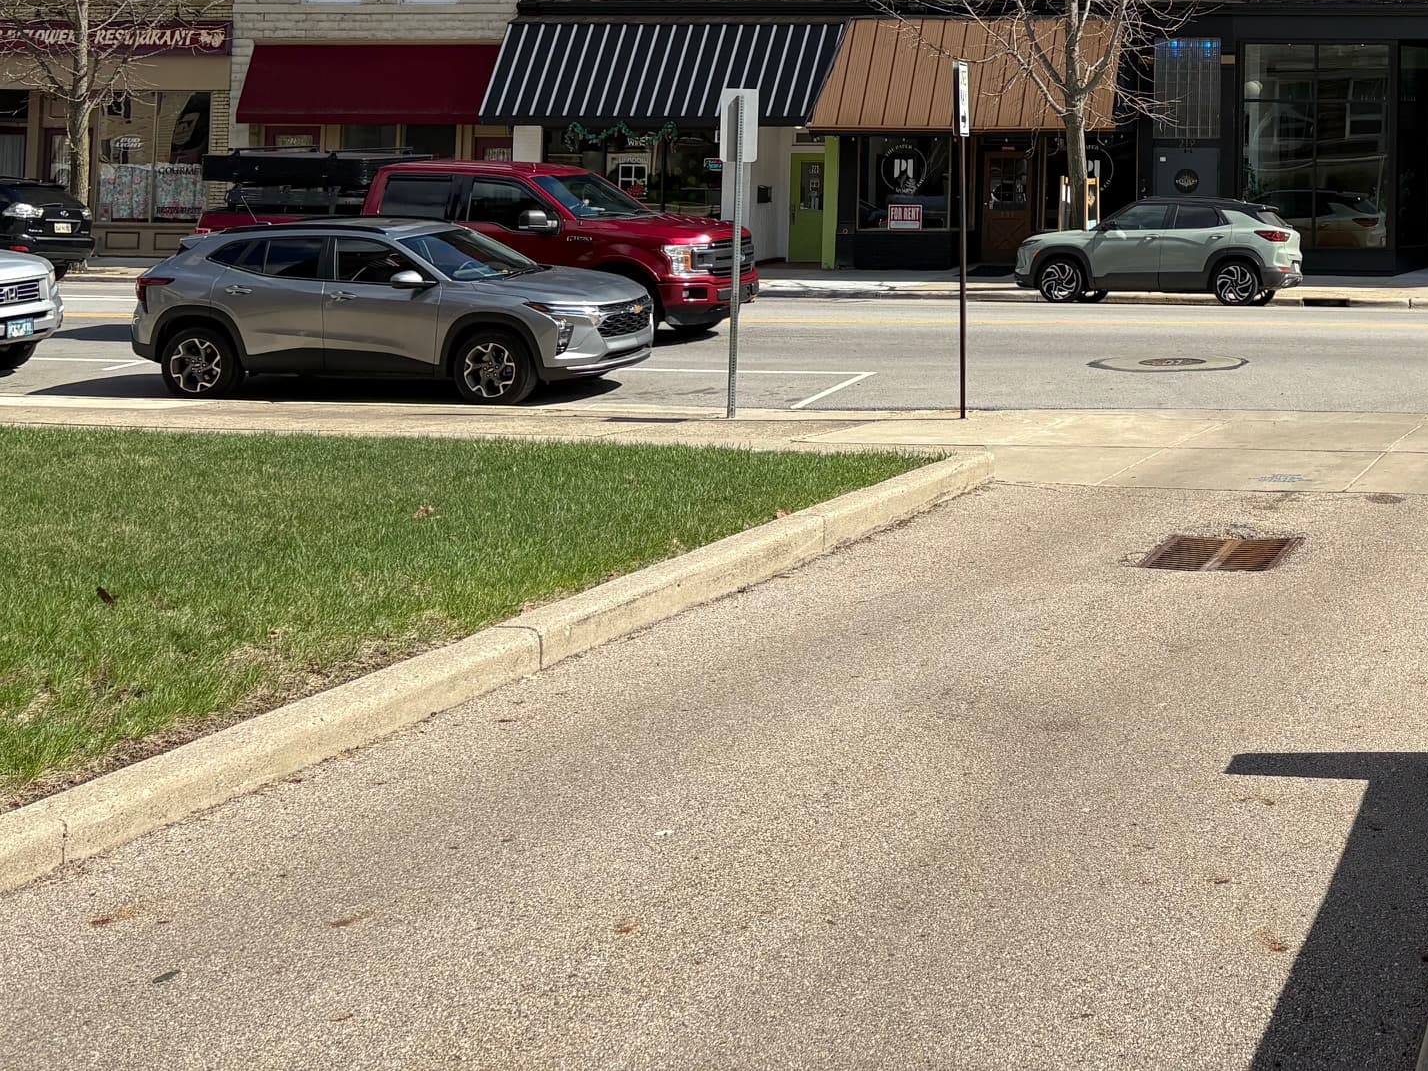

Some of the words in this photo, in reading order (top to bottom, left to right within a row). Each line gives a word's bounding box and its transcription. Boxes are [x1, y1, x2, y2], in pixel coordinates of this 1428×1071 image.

[94, 28, 194, 46] RESTAURANT
[890, 207, 902, 220] FOR
[903, 207, 920, 220] RENT
